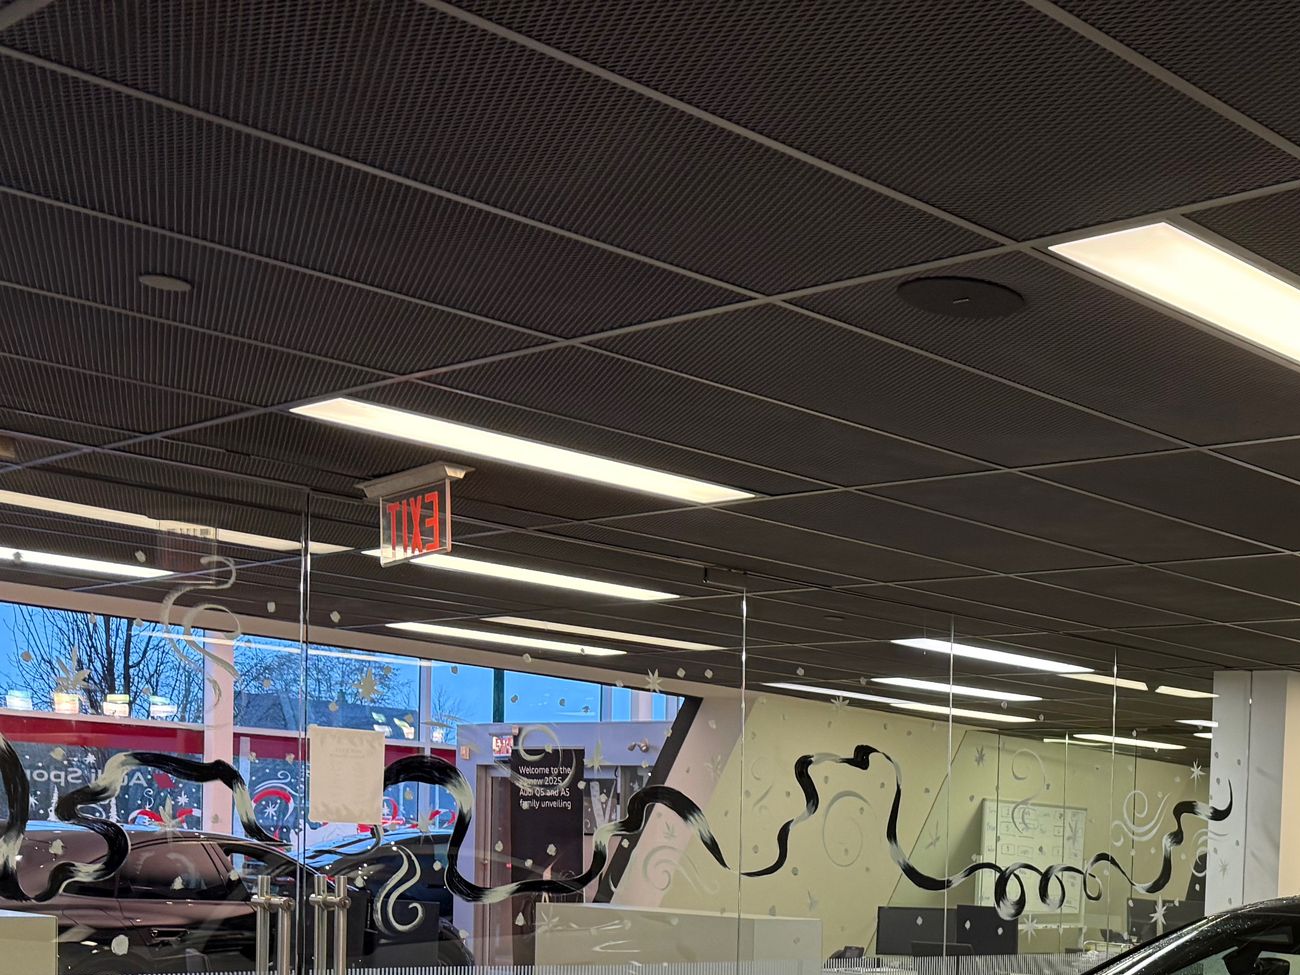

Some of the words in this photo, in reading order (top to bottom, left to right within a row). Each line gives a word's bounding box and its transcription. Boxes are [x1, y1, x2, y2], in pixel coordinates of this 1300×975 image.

[519, 766, 549, 774] Welcome
[559, 766, 571, 774] the
[544, 776, 562, 785] 2025
[546, 788, 559, 797] and
[560, 788, 570, 797] A5
[541, 800, 571, 809] unveiling
